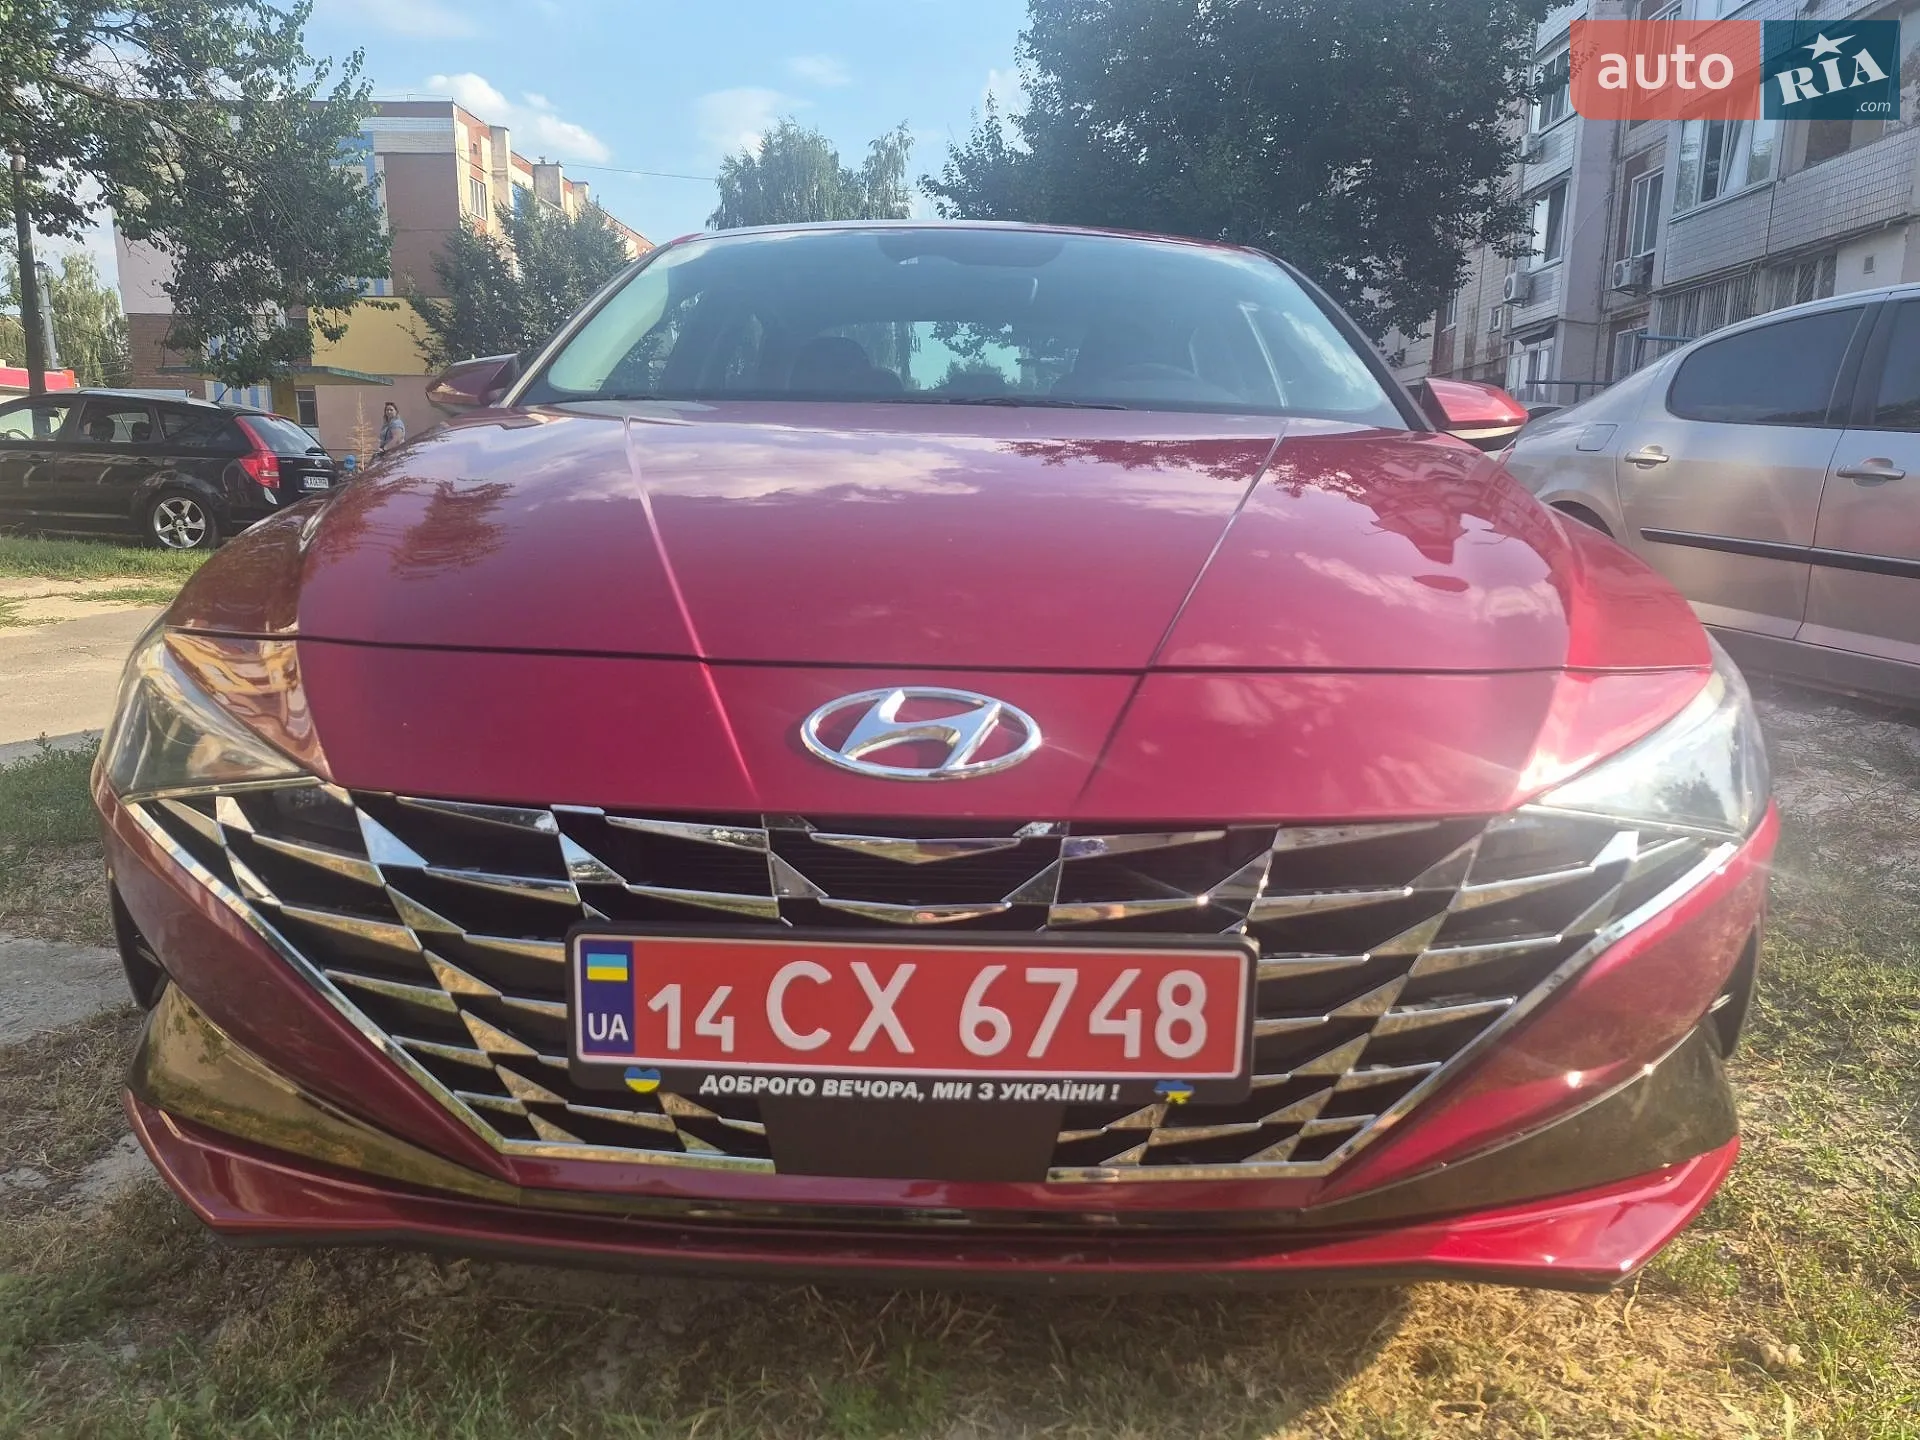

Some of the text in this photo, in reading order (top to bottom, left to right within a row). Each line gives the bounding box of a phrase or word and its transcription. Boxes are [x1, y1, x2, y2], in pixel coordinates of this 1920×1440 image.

[647, 960, 1207, 1060] 14 CX 6748
[588, 1012, 630, 1042] UA
[699, 1074, 816, 1097] ДОБРОГО
[821, 1079, 925, 1102] ВЕЧОРА,
[932, 1081, 973, 1100] МИ
[977, 1082, 995, 1100] З
[1000, 1079, 1105, 1101] УКРАЇНИ
